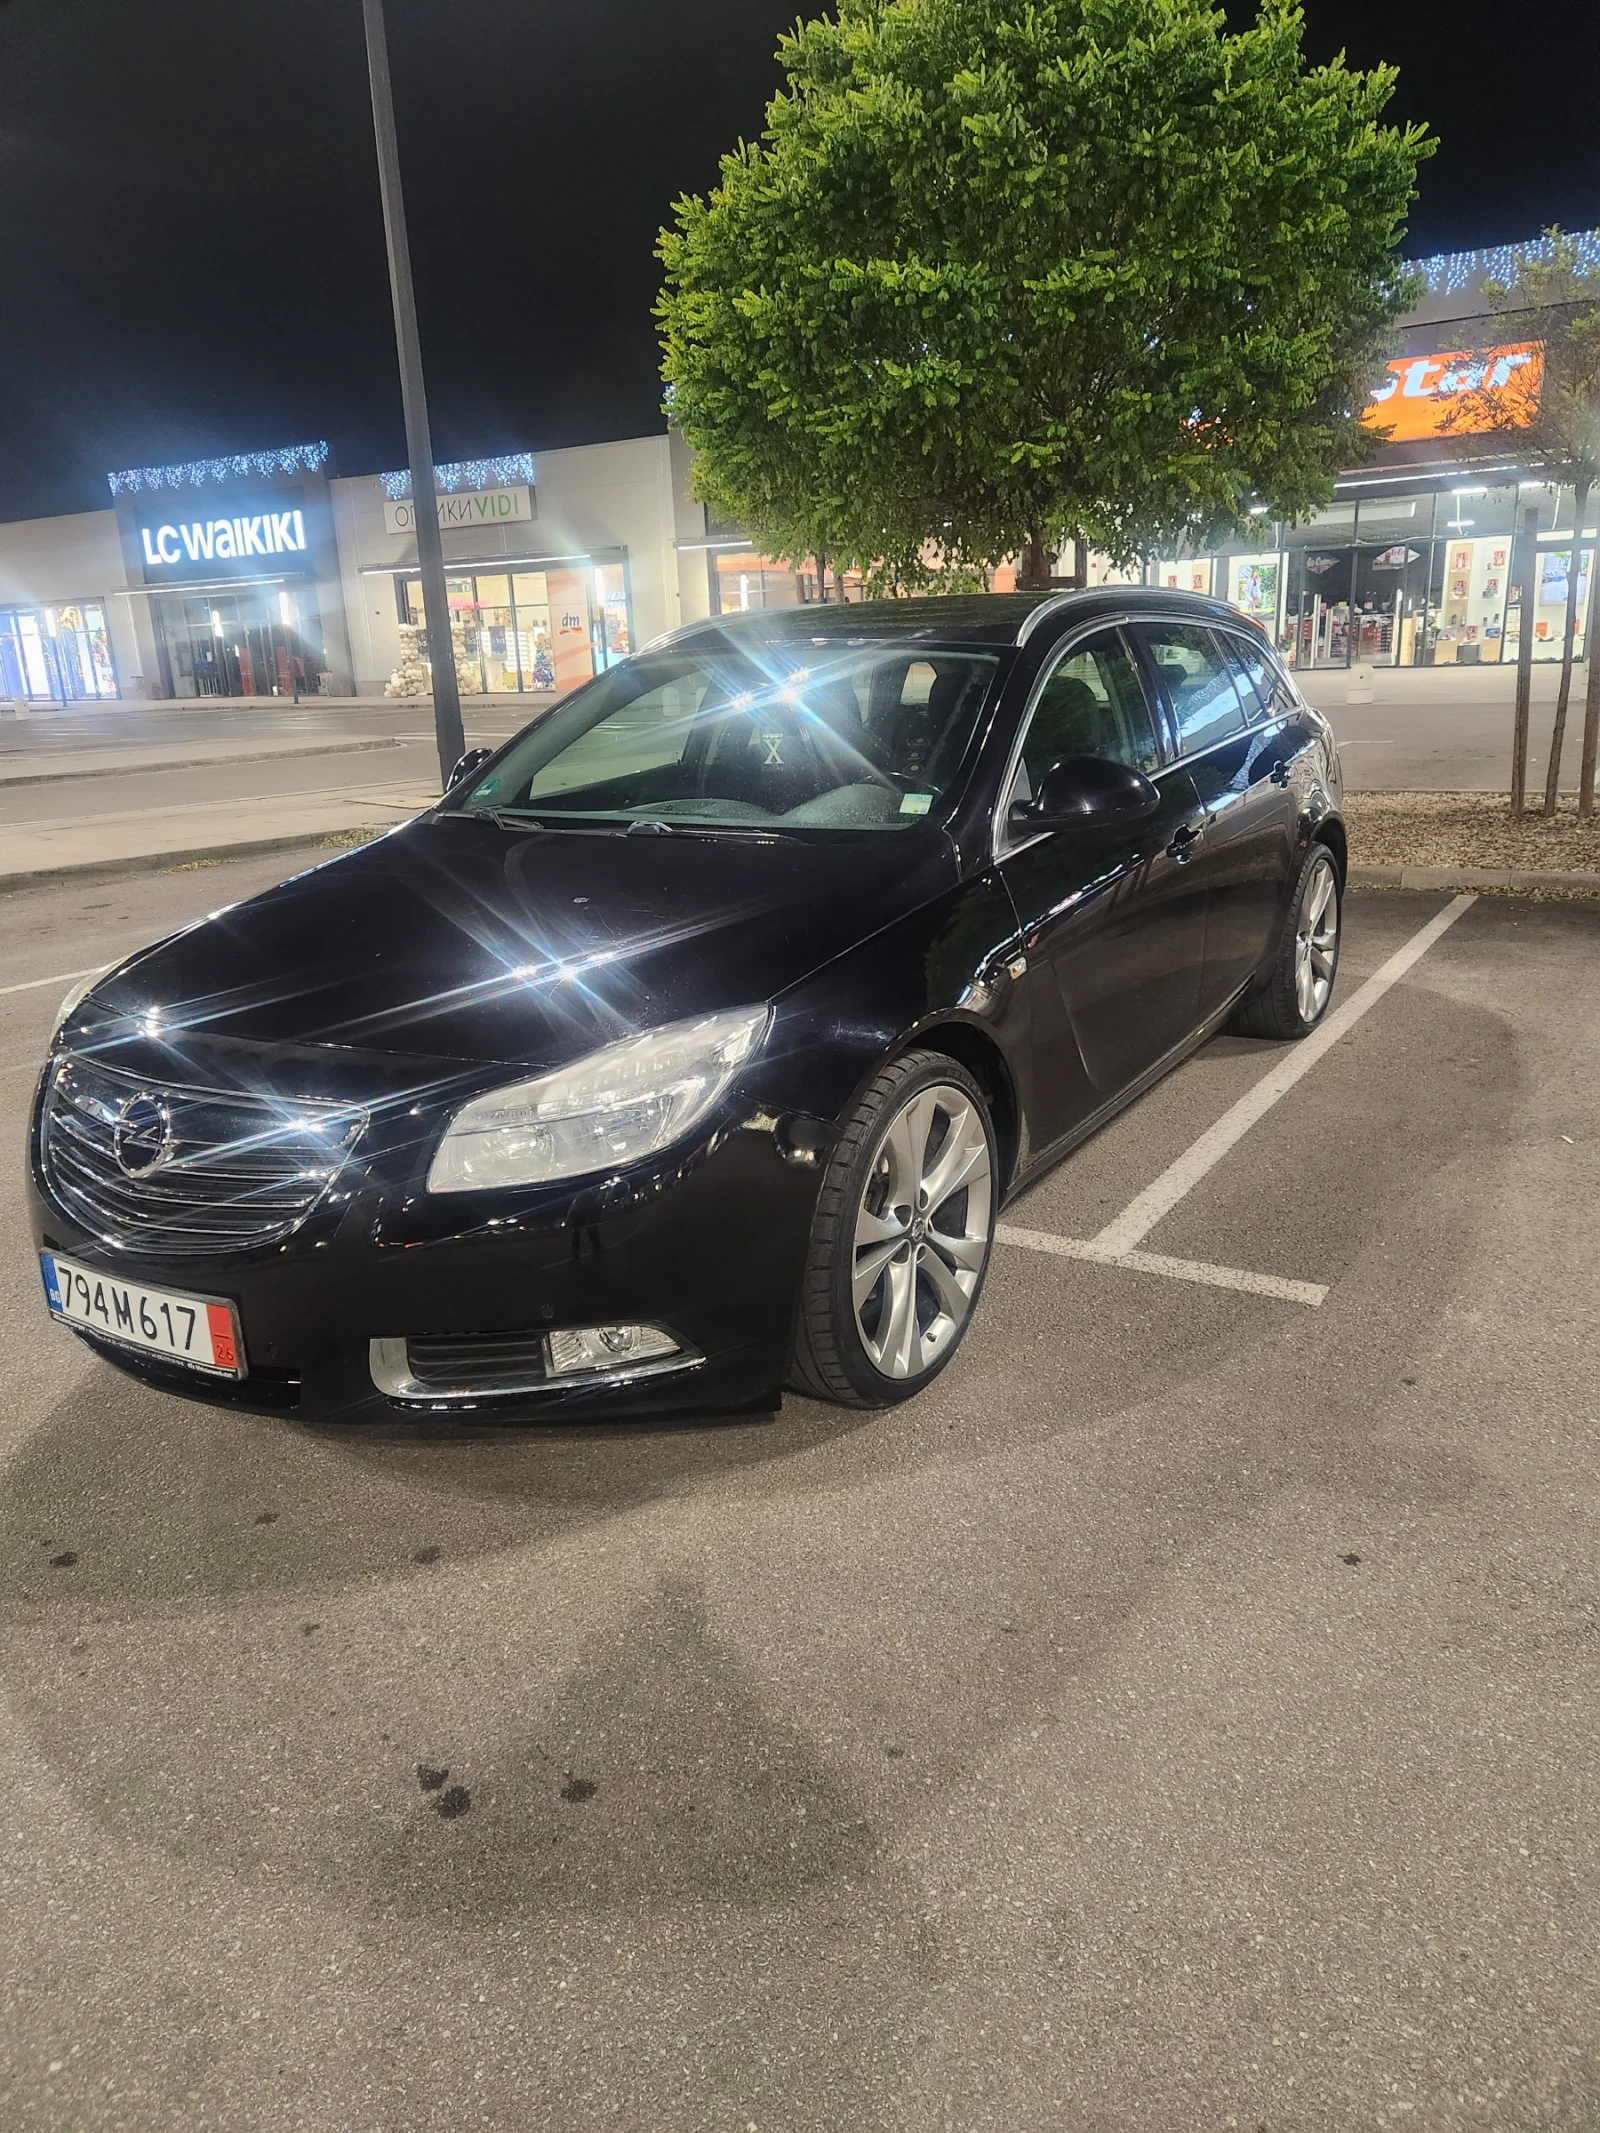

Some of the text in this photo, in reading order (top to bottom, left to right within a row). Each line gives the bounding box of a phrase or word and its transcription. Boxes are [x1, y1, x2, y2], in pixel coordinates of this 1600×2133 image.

[394, 493, 519, 527] ОИКИ VIDI
[142, 525, 181, 565] LC
[562, 612, 580, 627] dm
[50, 1288, 62, 1304] BG
[57, 1266, 196, 1351] 794M617
[216, 1344, 234, 1361] 26
